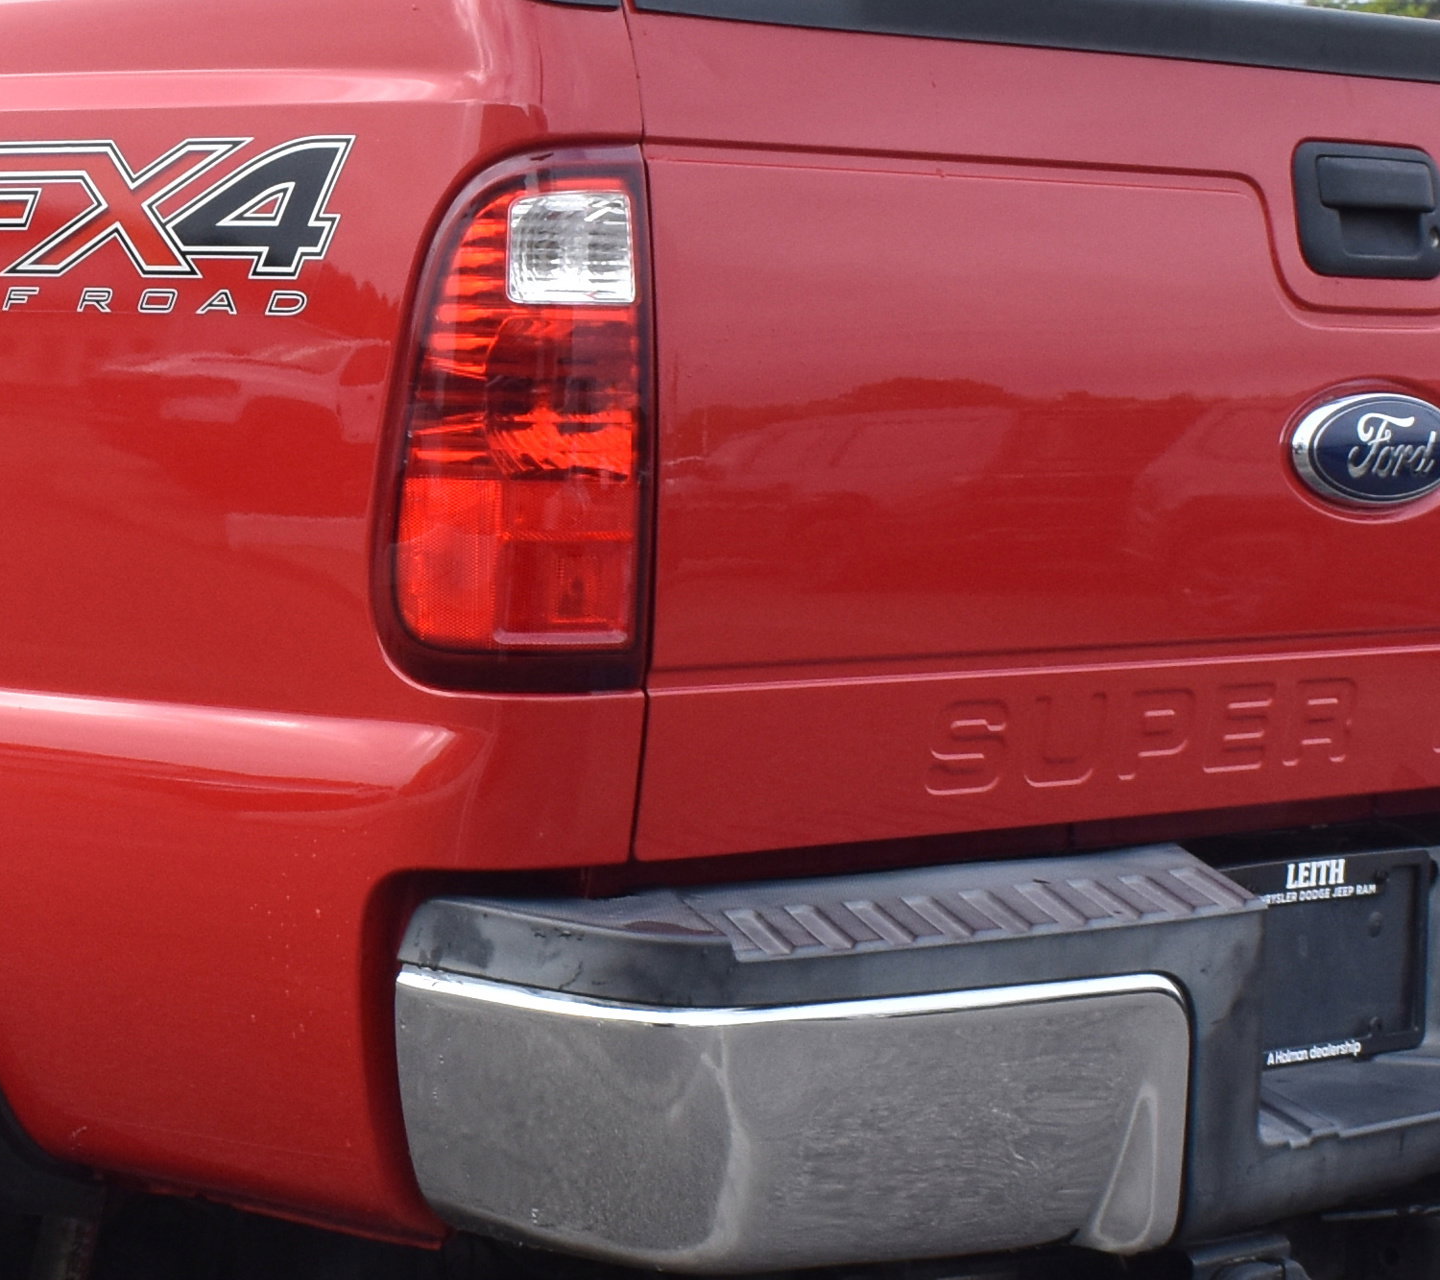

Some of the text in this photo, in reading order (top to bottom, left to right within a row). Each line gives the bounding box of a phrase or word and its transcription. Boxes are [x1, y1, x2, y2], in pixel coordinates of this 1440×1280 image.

[76, 287, 308, 316] ROAD
[1346, 411, 1438, 479] Ford
[924, 677, 1358, 795] SUPER
[1286, 859, 1346, 890] LEITH
[1299, 888, 1331, 901] DODGE
[1332, 886, 1354, 898] JEEP
[1356, 884, 1376, 895] RAM
[1267, 1039, 1362, 1066] A Holman dealership
